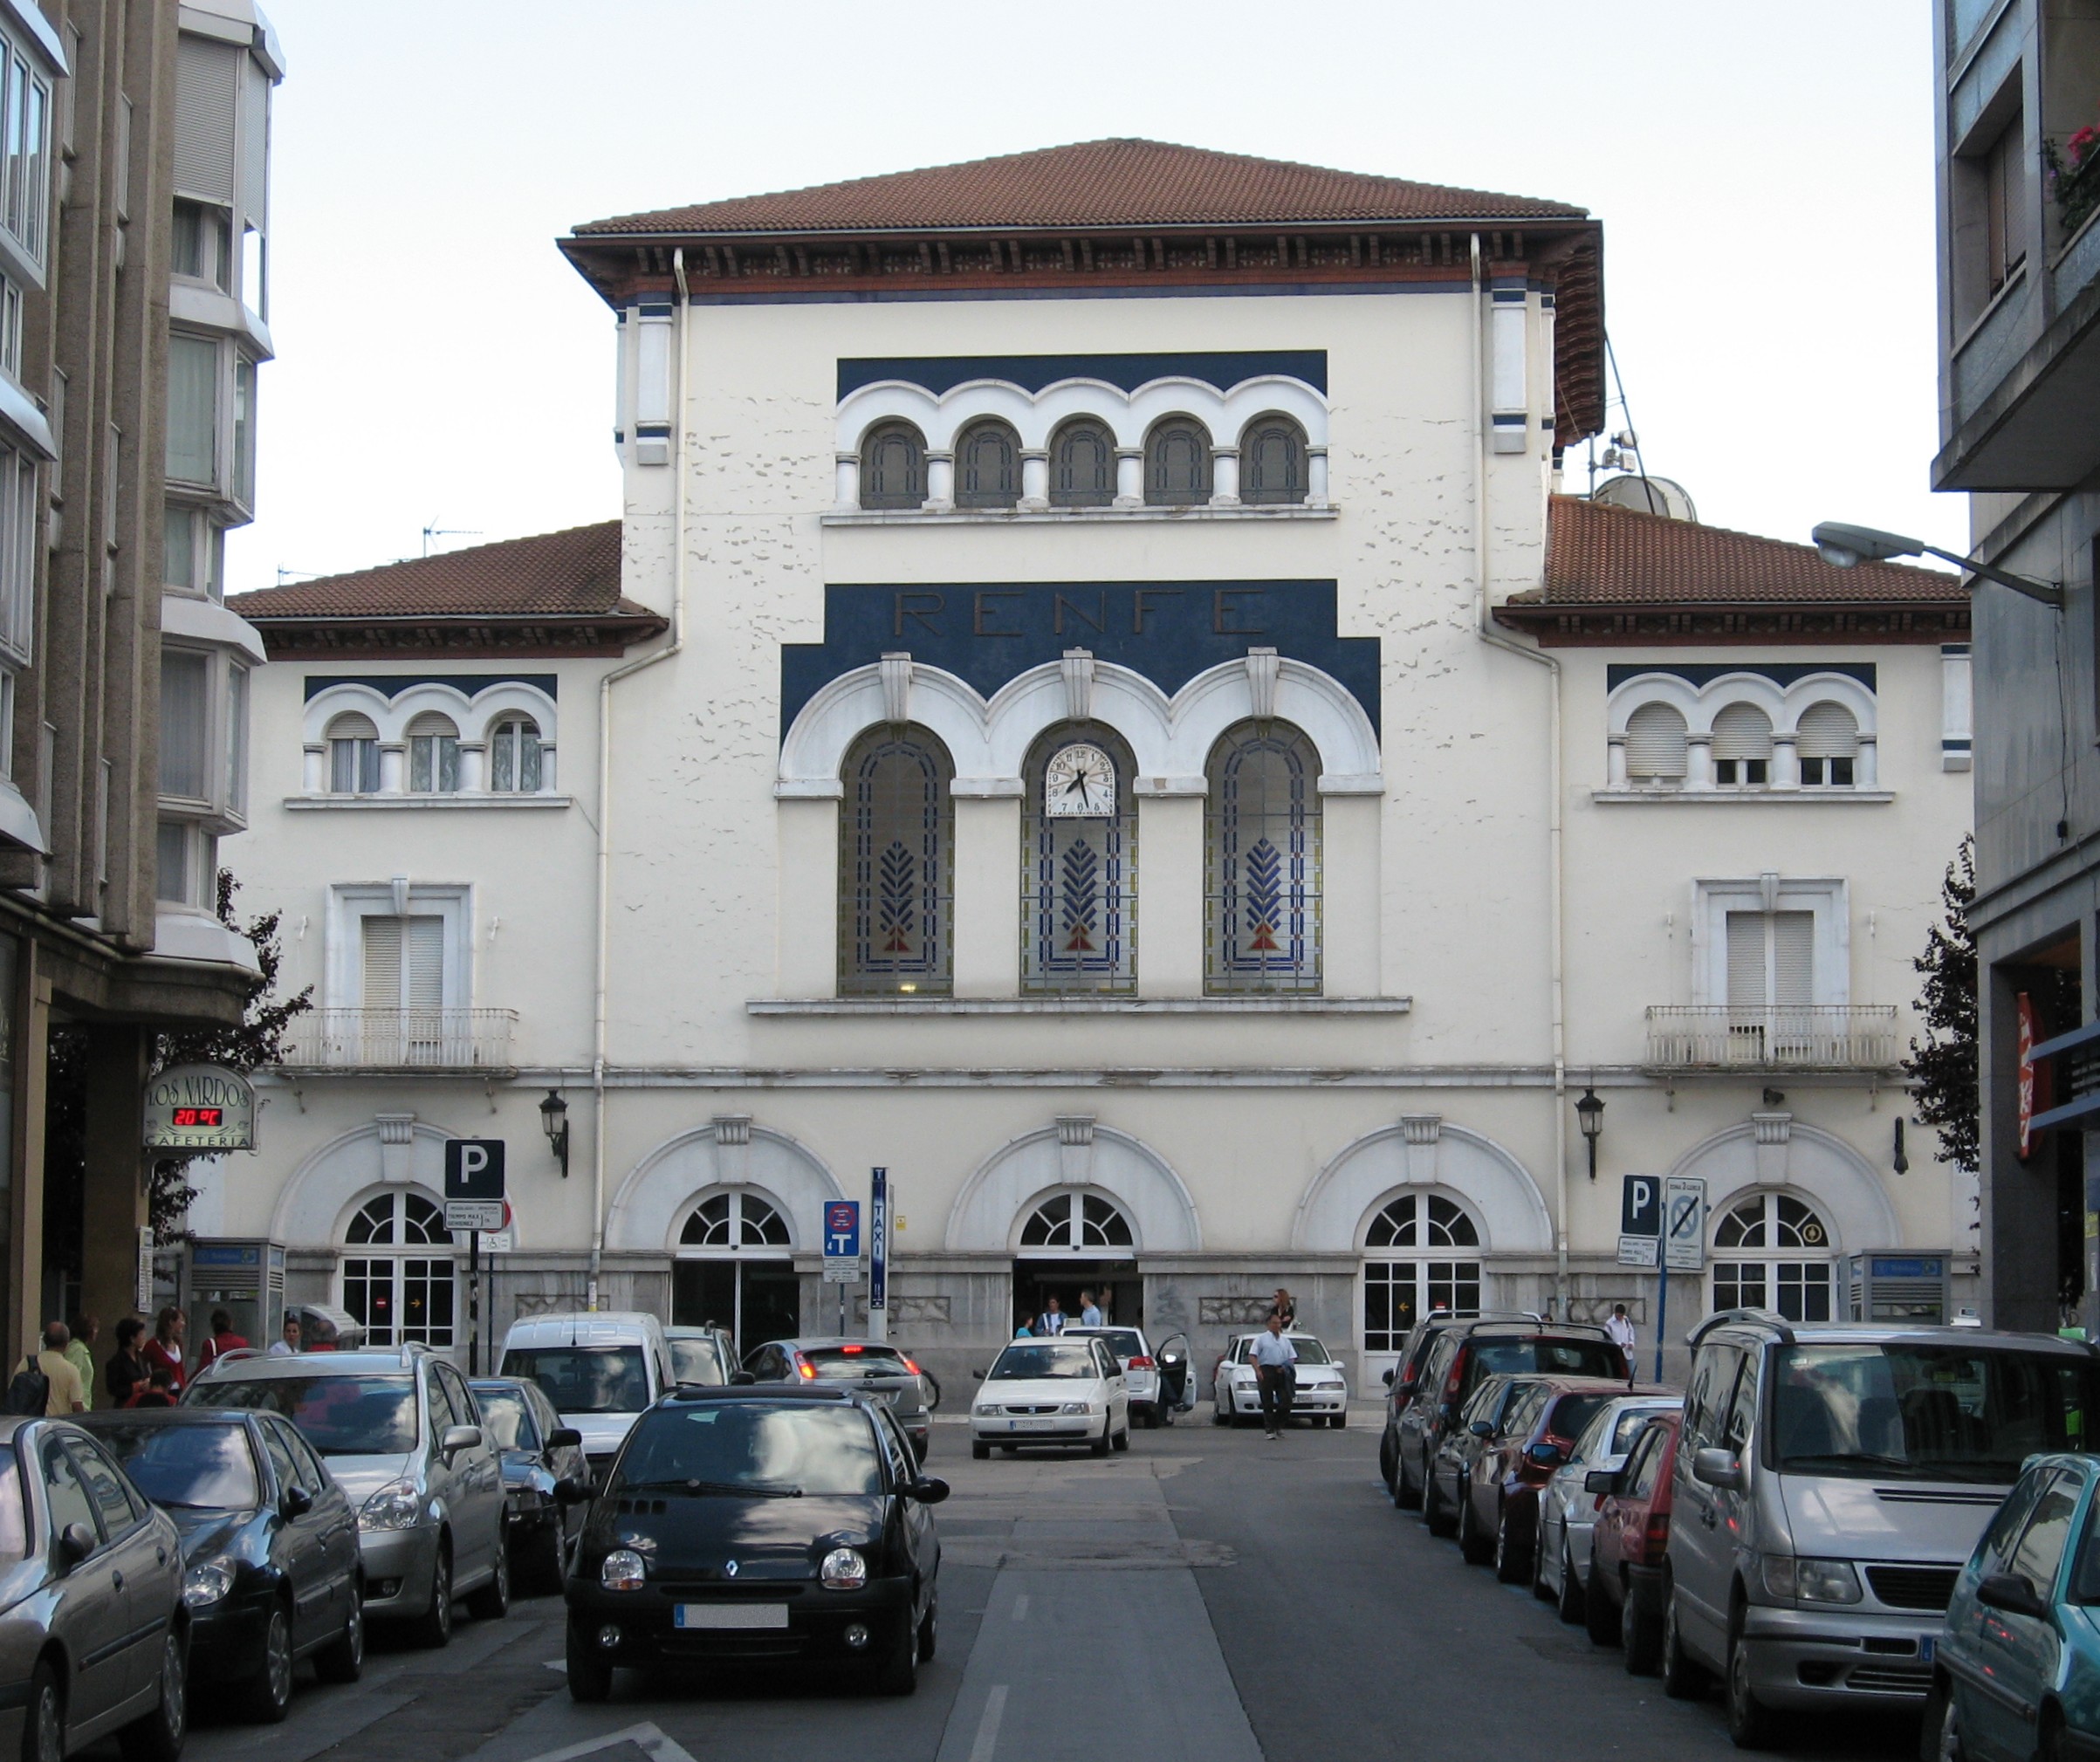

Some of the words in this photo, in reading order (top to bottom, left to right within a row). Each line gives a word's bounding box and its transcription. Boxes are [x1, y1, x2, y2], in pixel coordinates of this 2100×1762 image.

[893, 589, 1265, 636] RENFE
[1066, 753, 1073, 762] 11
[1061, 803, 1067, 812] 7
[148, 1079, 179, 1106] LOS
[183, 1076, 250, 1107] NARDOS
[175, 1109, 196, 1126] 20
[145, 1135, 250, 1146] CAFETERIA
[461, 1144, 489, 1183] P
[875, 1169, 883, 1179] T
[1632, 1181, 1651, 1219] P
[875, 1205, 883, 1255] TAXI
[831, 1234, 852, 1254] T
